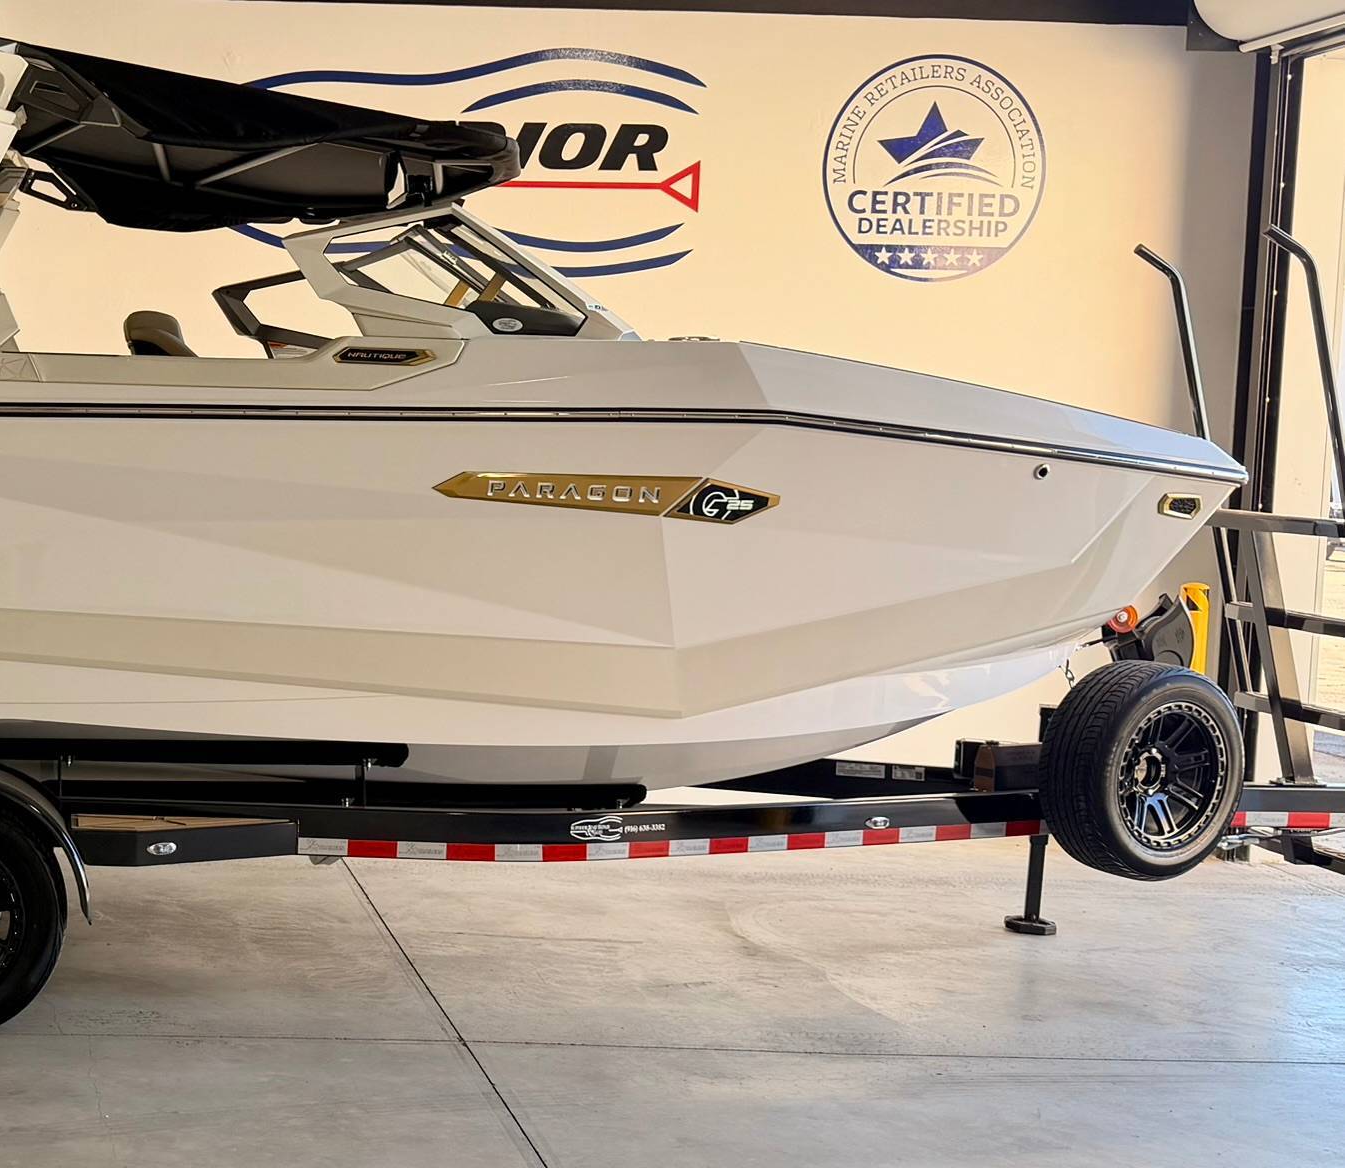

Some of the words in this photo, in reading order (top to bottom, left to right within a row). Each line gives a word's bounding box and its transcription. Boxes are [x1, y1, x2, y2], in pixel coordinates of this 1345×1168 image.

[833, 105, 867, 184] MARINE
[864, 64, 967, 107] RETAILERS
[969, 74, 1037, 190] ASSOCIATION
[458, 121, 669, 171] IOR
[847, 189, 1020, 217] CERTIFIED
[857, 217, 1008, 238] DEALERSHIP
[347, 351, 407, 360] NAUTIQUE
[487, 479, 662, 504] PARAGON
